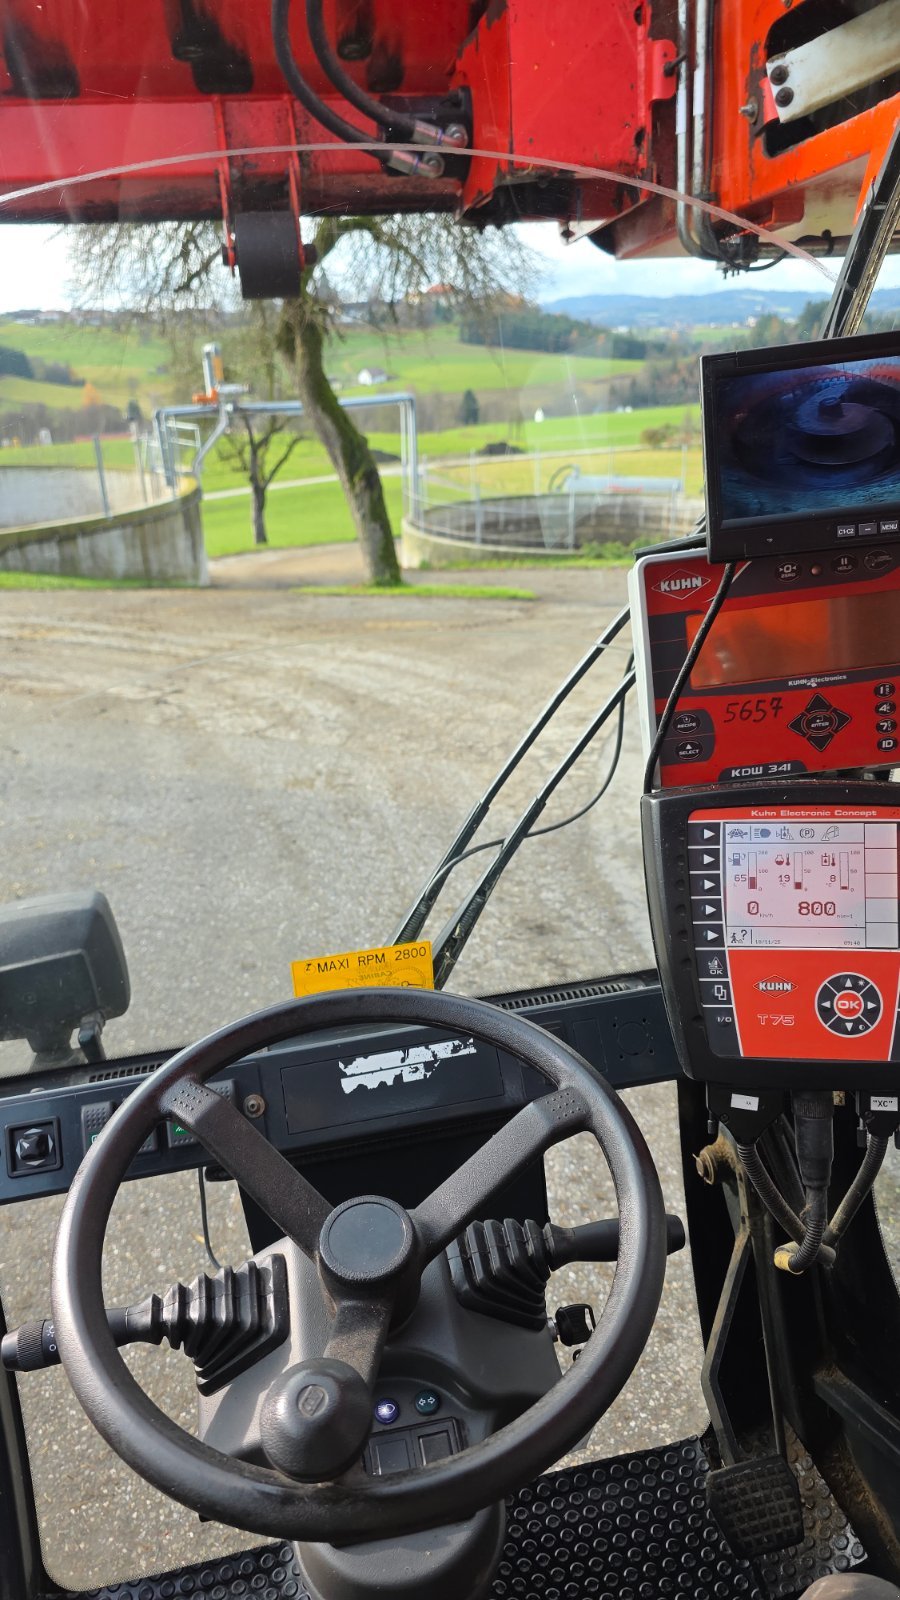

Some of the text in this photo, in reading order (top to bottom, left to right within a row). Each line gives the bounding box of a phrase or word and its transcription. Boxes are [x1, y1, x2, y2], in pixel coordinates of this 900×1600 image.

[660, 577, 702, 592] KUHN
[723, 697, 783, 723] 5657
[879, 704, 887, 712] 4
[880, 722, 888, 730] 7
[731, 766, 763, 777] KDW
[780, 809, 831, 817] Electronic
[834, 809, 877, 818] Concept
[747, 901, 759, 915] 0
[798, 901, 836, 916] 800
[317, 958, 349, 973] MAXI
[357, 953, 386, 966] RPM
[395, 946, 426, 961] 2800
[758, 982, 792, 991] KUHN
[837, 1000, 860, 1010] OK
